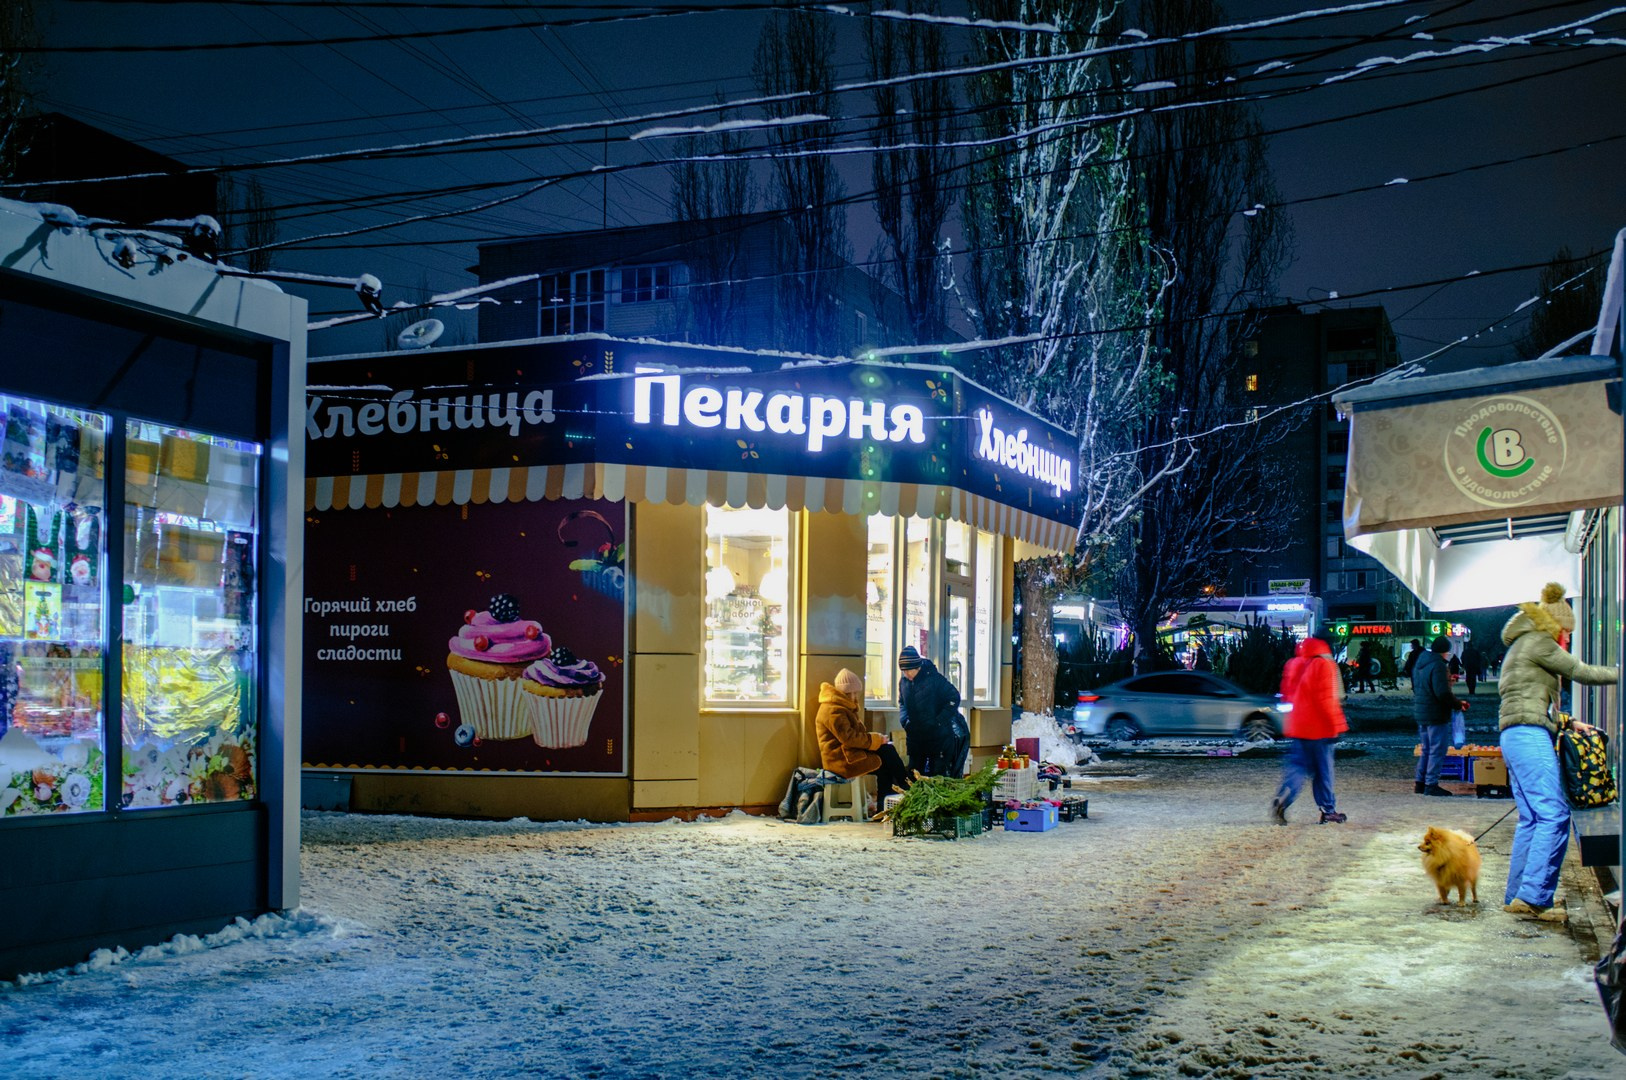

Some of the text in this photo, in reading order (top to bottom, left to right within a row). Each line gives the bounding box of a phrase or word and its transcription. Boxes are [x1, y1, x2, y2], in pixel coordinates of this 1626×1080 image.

[634, 366, 925, 453] Пекарня
[1454, 402, 1557, 444] Продовольствие
[979, 409, 1071, 497] Хлебница
[1456, 464, 1553, 499] в удовольствие
[304, 596, 417, 617] Горячий хлеб
[329, 624, 390, 641] пироги
[1352, 624, 1392, 634] АПТЕКА
[317, 645, 402, 660] сладости
